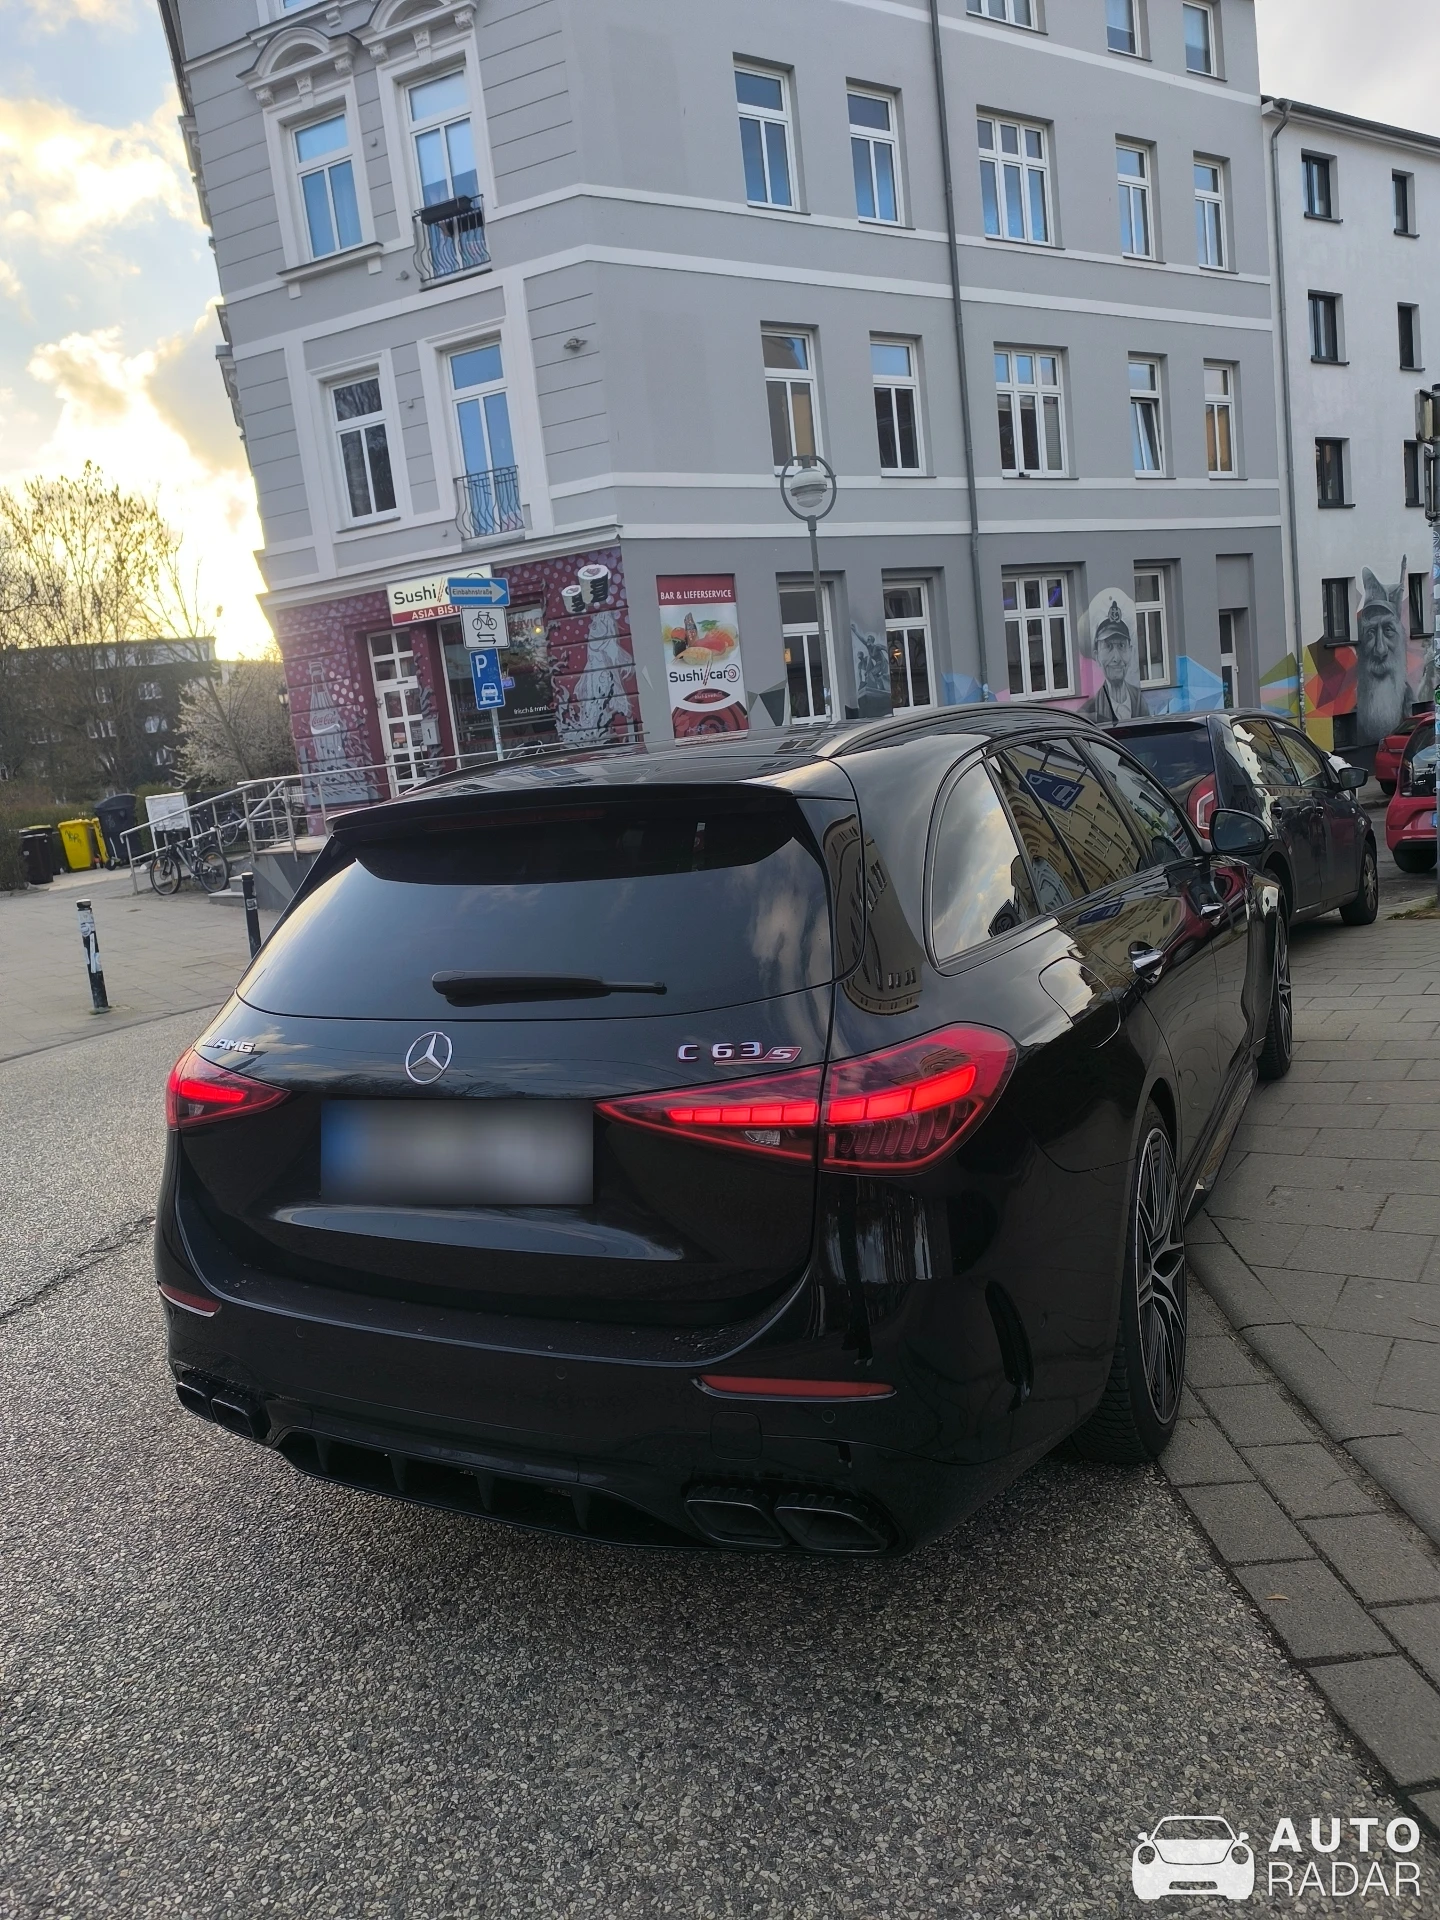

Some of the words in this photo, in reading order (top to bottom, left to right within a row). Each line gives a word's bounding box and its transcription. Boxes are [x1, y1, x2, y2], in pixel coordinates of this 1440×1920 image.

[394, 583, 437, 605] Sushi
[660, 591, 675, 600] BAR
[676, 591, 682, 599] &
[683, 589, 732, 599] LIEFERSERVICE
[411, 609, 435, 620] ASIA
[474, 654, 487, 678] P
[669, 668, 703, 683] Sushi
[213, 1038, 256, 1053] AMG
[677, 1043, 699, 1061] C
[711, 1041, 763, 1060] 63
